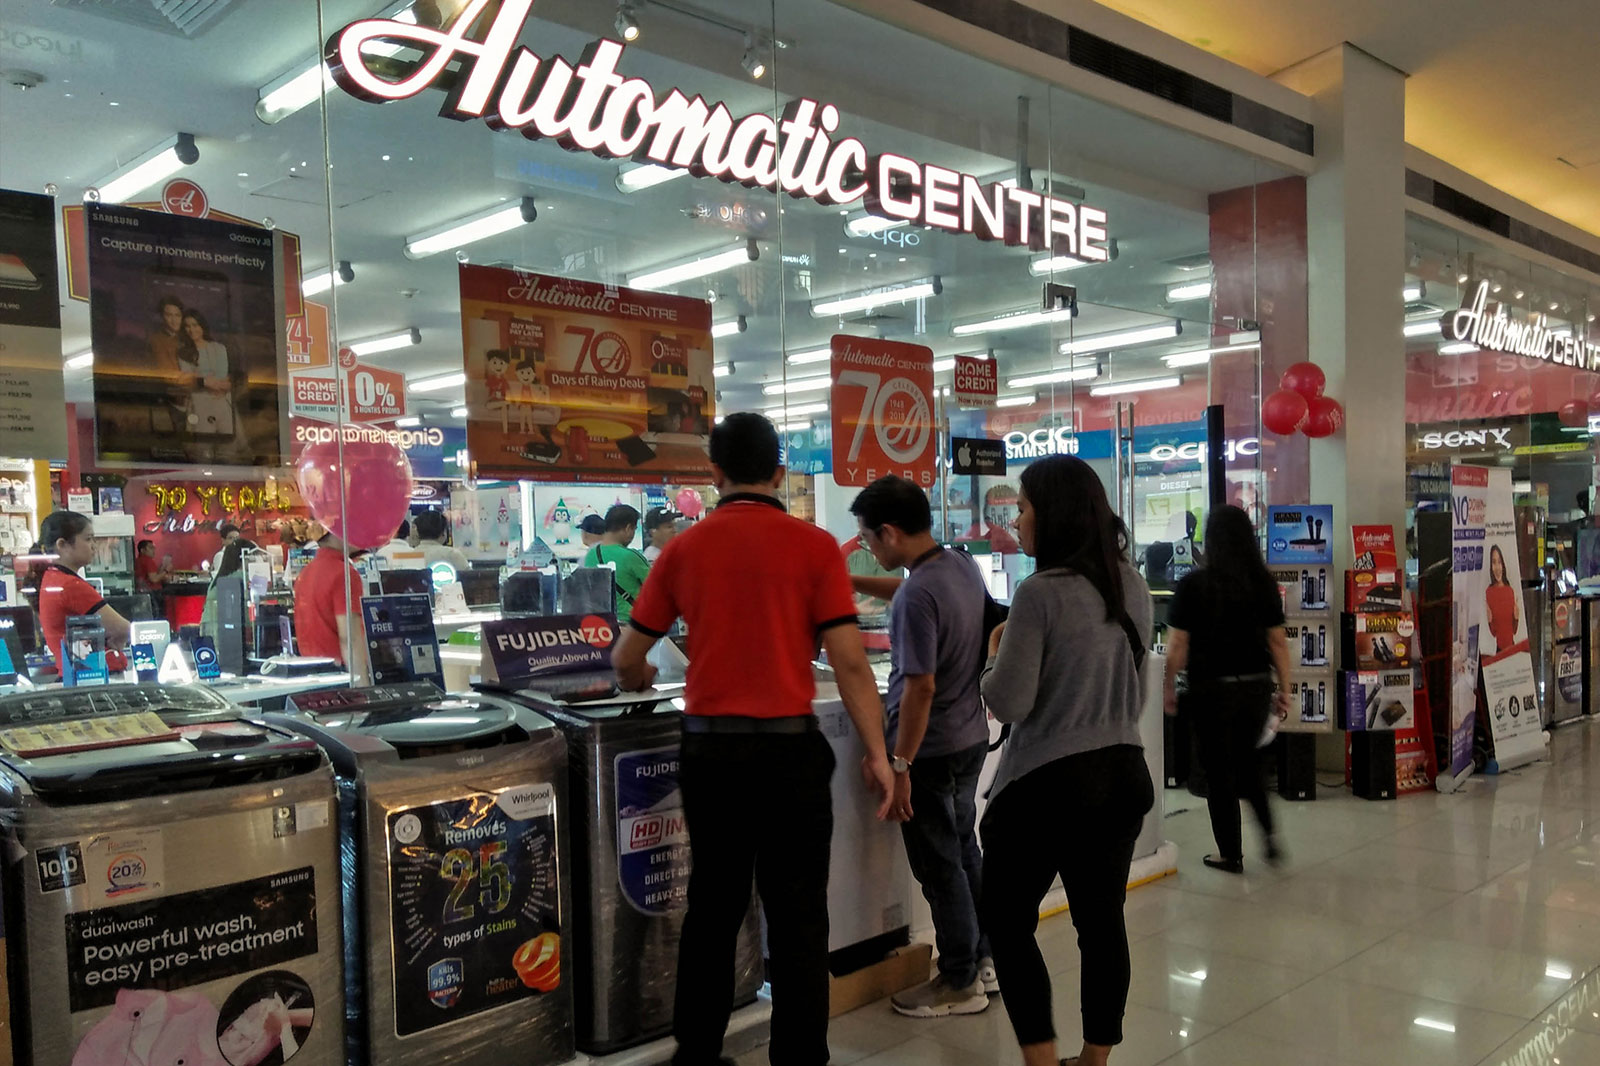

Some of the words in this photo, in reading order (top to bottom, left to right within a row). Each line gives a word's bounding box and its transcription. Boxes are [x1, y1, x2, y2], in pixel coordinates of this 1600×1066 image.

[338, 0, 868, 206] Automatic
[878, 152, 1108, 262] CENTRE
[92, 212, 140, 228] SAMSUNG
[229, 232, 262, 247] Galaxy
[100, 236, 153, 252] Capture
[155, 245, 213, 262] moments
[214, 252, 266, 271] perfectly
[507, 276, 615, 312] Automatic
[619, 302, 678, 321] CENTRE
[1453, 279, 1552, 360] Automatic
[832, 344, 895, 368] Automatic
[897, 359, 934, 373] CENTRE
[956, 362, 991, 378] HOME
[297, 380, 337, 392] HOME
[354, 371, 396, 407] 0%
[551, 373, 578, 387] Days
[578, 374, 590, 386] of
[591, 375, 618, 390] Rainy
[619, 376, 646, 390] Deals
[957, 377, 996, 391] CREDIT
[359, 405, 380, 415] MONTHS
[381, 405, 401, 415] PROMO
[837, 369, 931, 464] 70
[1423, 427, 1512, 449] SONY
[606, 452, 623, 460] FREE
[1005, 437, 1080, 460] SAMSUNG
[1160, 480, 1191, 490] DIESEL
[1452, 496, 1469, 525] NO
[1356, 530, 1391, 542] Automatic
[371, 622, 394, 633] FREE
[139, 632, 166, 641] Galaxy
[496, 625, 615, 652] FUJIDENZO
[527, 656, 561, 669] Quality
[562, 654, 590, 664] Above
[590, 651, 602, 661] All
[1560, 660, 1575, 675] FIRST
[79, 671, 103, 679] SAMSUNG
[511, 789, 550, 805] Whirlpool
[444, 819, 507, 846] Removes
[635, 821, 660, 838] HD
[270, 871, 309, 889] SAMSUNG
[440, 840, 512, 924] 25
[644, 868, 675, 885] DIRECT
[645, 888, 673, 905] HEAVY
[81, 915, 155, 939] dualwash
[443, 929, 472, 949] types
[473, 925, 485, 939] of
[486, 918, 518, 935] Stains
[84, 926, 189, 964] Powerful
[194, 914, 257, 940] wash,
[85, 960, 144, 986] easy
[150, 920, 304, 978] pre-treatment
[438, 965, 454, 975] Kills
[432, 973, 460, 989] 99.9%
[486, 977, 519, 996] heater
